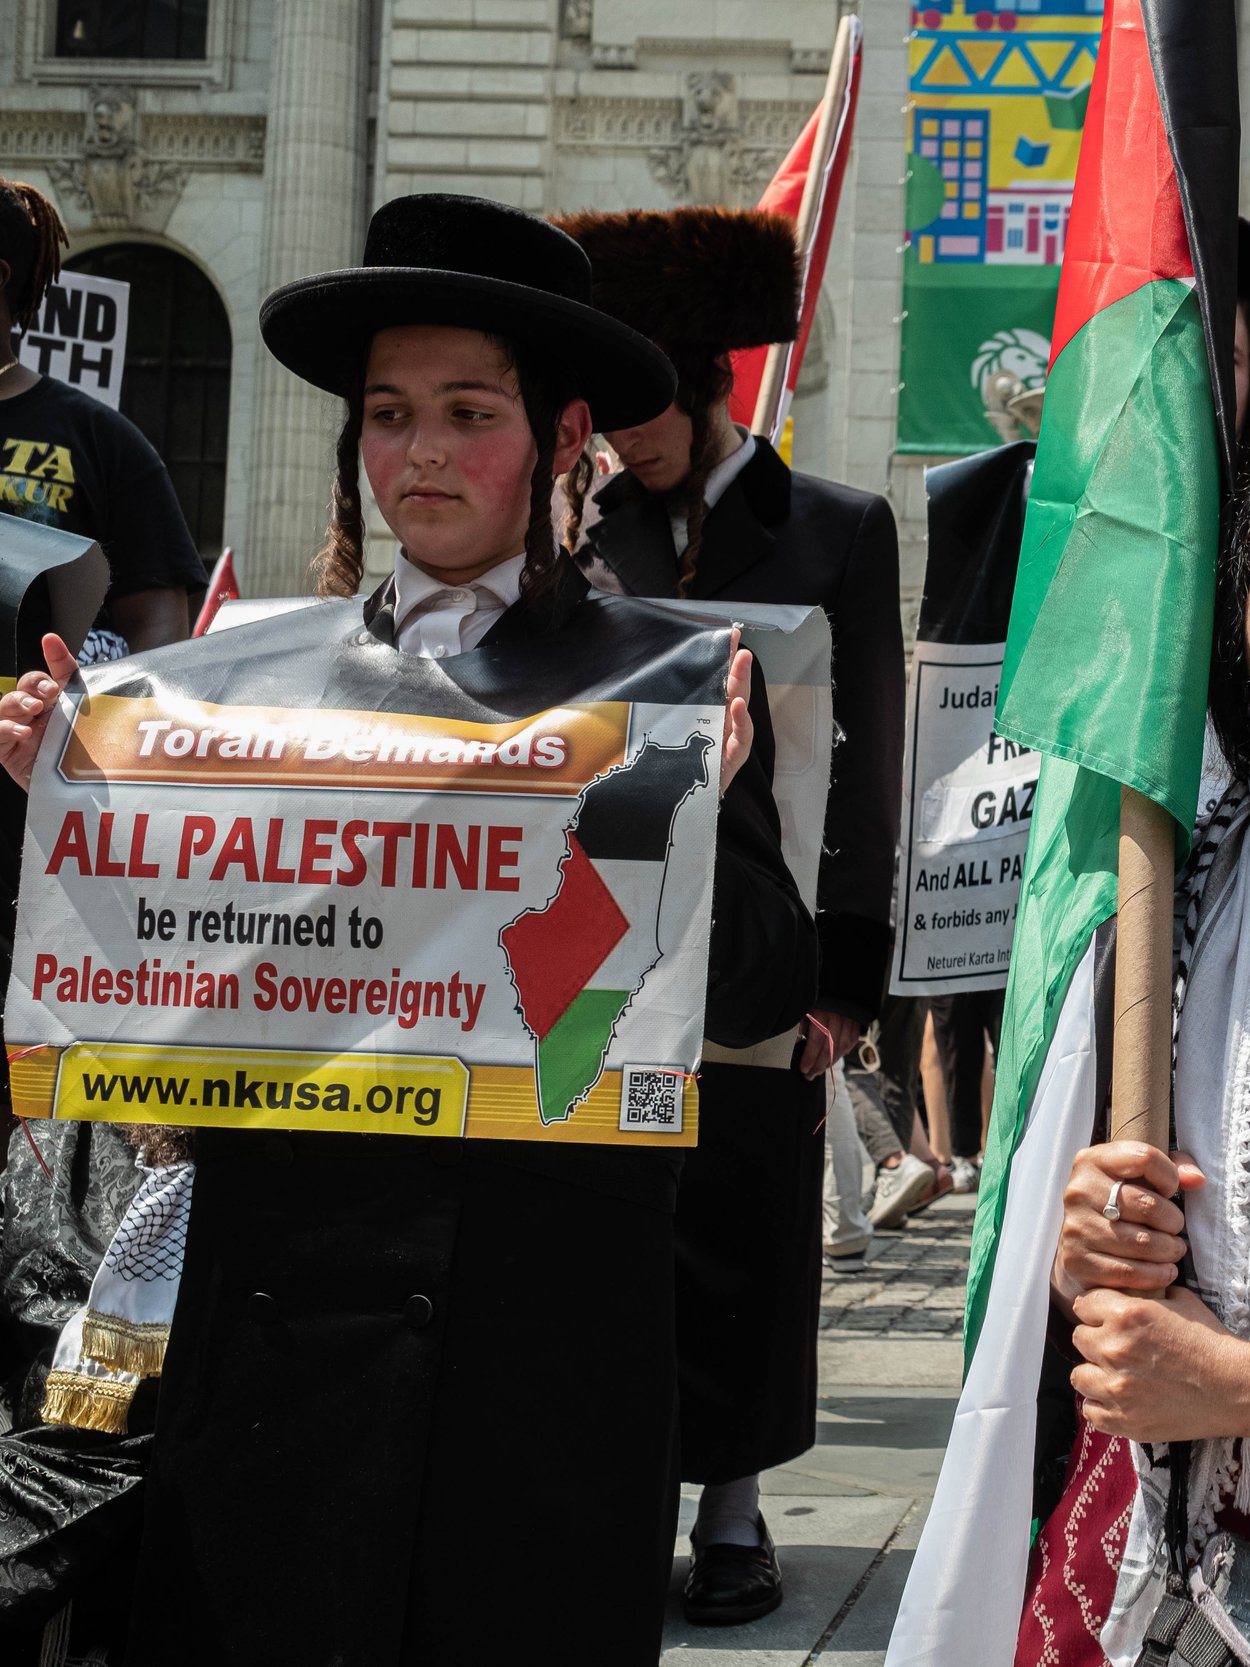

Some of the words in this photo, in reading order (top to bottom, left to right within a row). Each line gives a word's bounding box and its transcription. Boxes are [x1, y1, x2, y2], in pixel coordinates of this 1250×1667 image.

[303, 724, 568, 769] Demands
[45, 811, 160, 879] ALL
[176, 815, 523, 892] PALESTINE
[915, 866, 950, 892] And
[953, 860, 992, 889] ALL
[137, 897, 176, 942] be
[187, 901, 336, 948] returned
[348, 905, 384, 950] to
[913, 913, 927, 931] &
[931, 908, 982, 931] forbids
[985, 909, 1010, 926] any
[927, 953, 966, 970] Neturei
[968, 953, 995, 967] Karta
[33, 953, 239, 1009] Palestinian
[253, 962, 487, 1032] Sovereignty
[81, 1070, 442, 1126] www.nkusa.org
